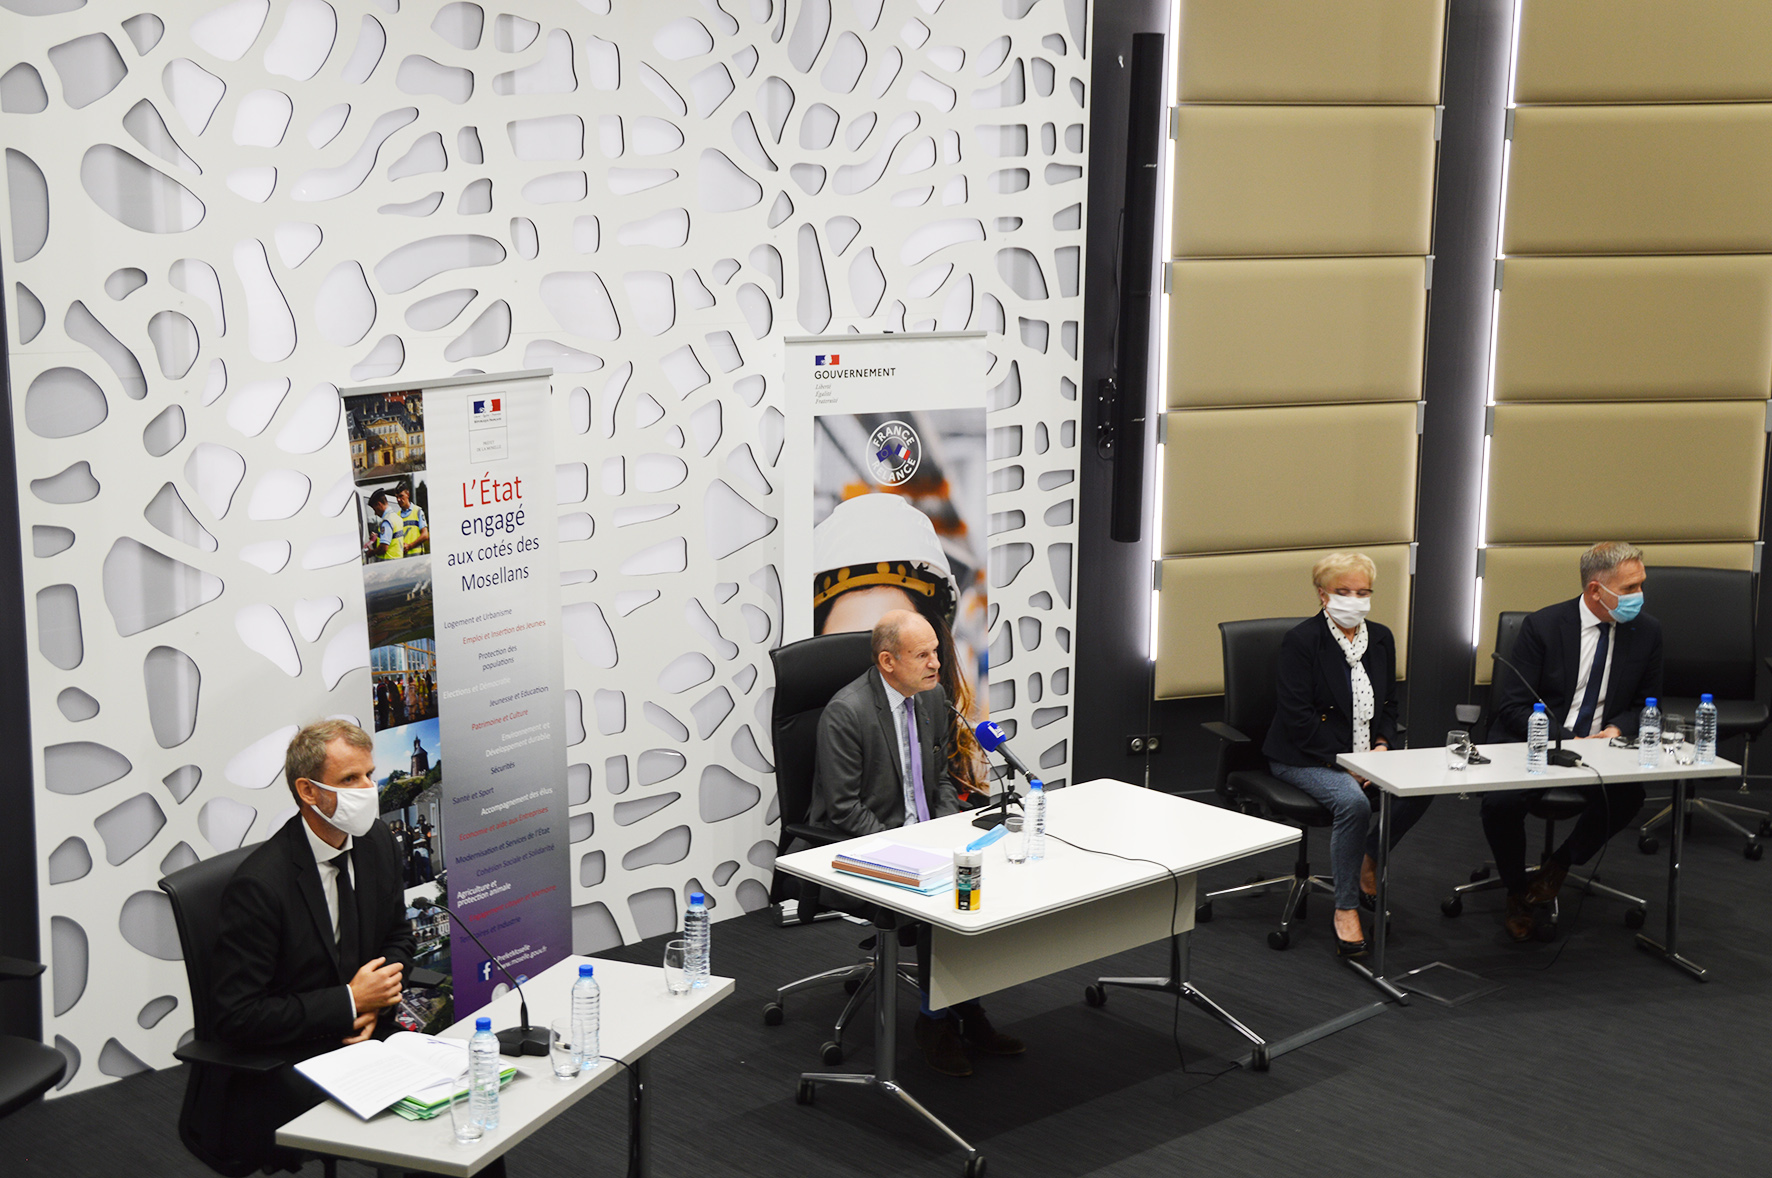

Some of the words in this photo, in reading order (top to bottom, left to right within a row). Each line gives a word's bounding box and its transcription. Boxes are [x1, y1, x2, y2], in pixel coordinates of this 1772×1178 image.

[814, 367, 896, 380] GOUVERNEMENT
[872, 425, 915, 447] FRANCE
[871, 457, 917, 482] RELANCE
[462, 471, 522, 508] L’État
[461, 503, 525, 537] engagé
[448, 550, 474, 566] aux
[478, 539, 513, 561] cotés
[517, 536, 539, 553] des
[462, 566, 529, 591] Mosellans
[443, 617, 475, 630] Logement
[476, 615, 482, 623] et
[483, 609, 512, 621] Urbanisme
[463, 634, 483, 645] Emploi
[491, 627, 515, 638] Insertion
[516, 624, 525, 632] des
[526, 620, 546, 630] Jeunes
[479, 648, 506, 660] Protection
[507, 645, 517, 653] des
[482, 657, 515, 672] populations
[443, 687, 471, 700] Elections
[472, 685, 479, 693] et
[480, 677, 511, 690] Démocratie
[489, 695, 513, 707] Jeunesse
[514, 692, 520, 700] et
[520, 685, 549, 698] Education
[471, 717, 502, 731] Patrimoine
[503, 714, 509, 722] et
[510, 709, 528, 720] Culture
[501, 723, 542, 741] Environnement
[485, 738, 527, 757] Développement
[528, 732, 551, 744] durable
[490, 761, 516, 775] Sécurités
[452, 793, 470, 805] Santé
[471, 791, 478, 800] et
[479, 787, 494, 798] Sport
[480, 793, 529, 816] Accompagnement
[529, 790, 539, 799] des
[540, 787, 553, 796] élus
[459, 827, 488, 842] Economie
[489, 824, 495, 832] et
[496, 820, 508, 829] aide
[508, 817, 518, 825] aux
[519, 807, 549, 821] Entreprises
[455, 845, 498, 864] Modernisation
[499, 843, 505, 851] et
[505, 836, 527, 848] Services
[527, 832, 534, 840] de
[476, 864, 502, 877] Cohésion
[502, 856, 521, 868] Sociale
[522, 853, 528, 861] et
[528, 842, 555, 859] Solidarité
[456, 883, 490, 900] Agriculture
[491, 880, 498, 888] et
[456, 891, 489, 909] protection
[489, 882, 512, 896] animale
[469, 904, 504, 922] Engagement
[505, 897, 524, 909] citoyen
[525, 893, 531, 901] et
